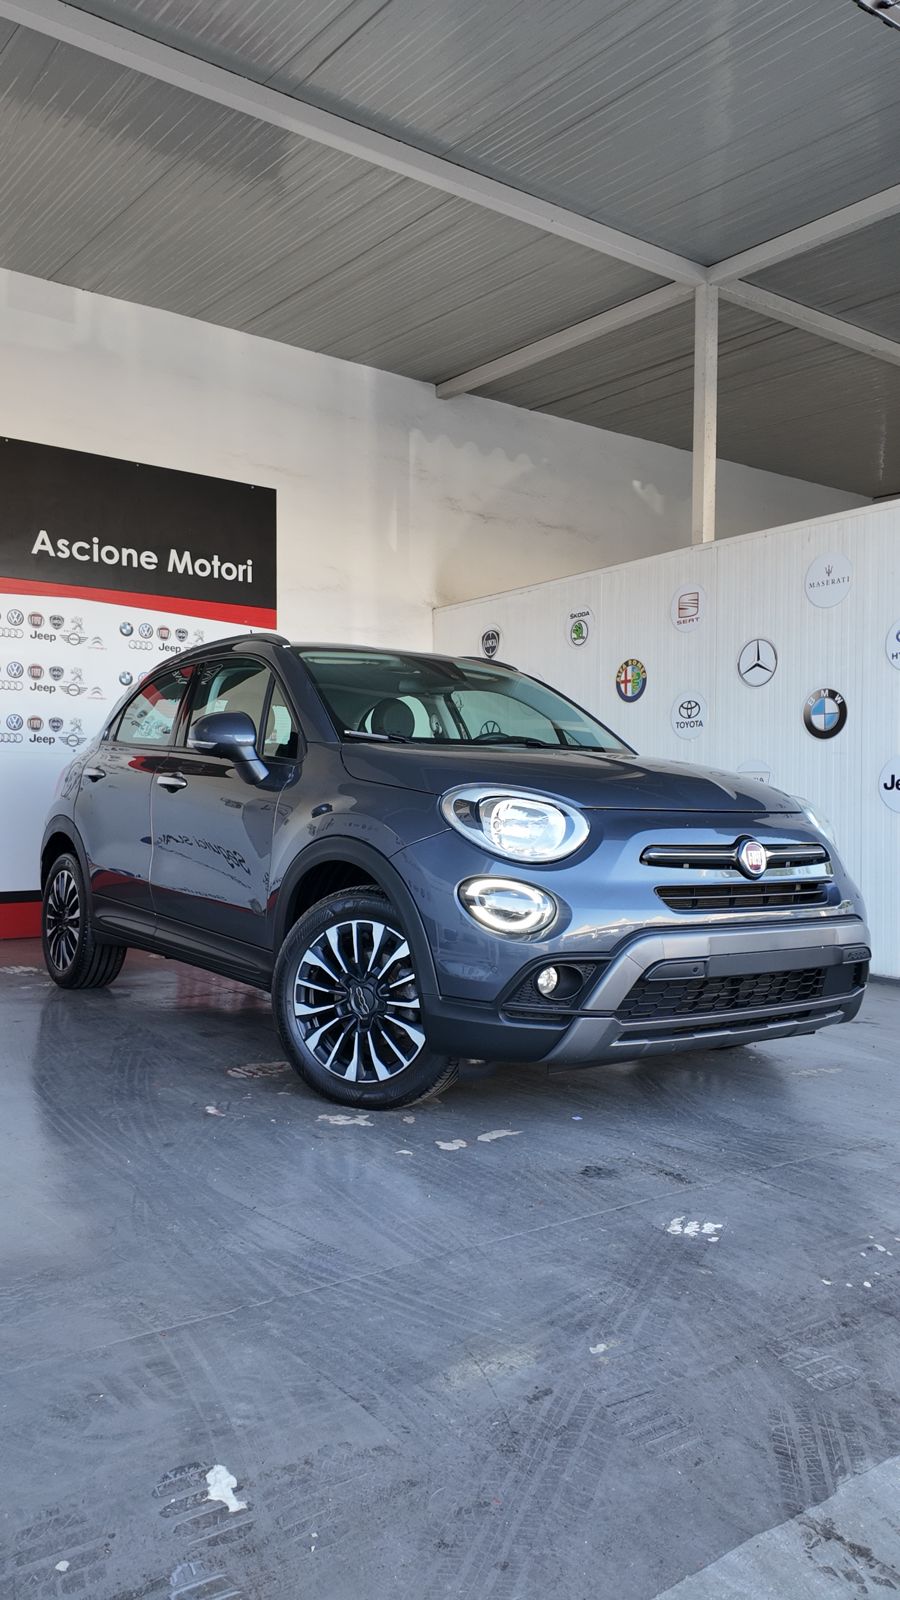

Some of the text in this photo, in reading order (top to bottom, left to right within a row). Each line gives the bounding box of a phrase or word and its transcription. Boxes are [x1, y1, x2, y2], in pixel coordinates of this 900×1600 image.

[31, 529, 253, 583] Ascione Motori
[808, 576, 850, 589] MASERATI
[676, 617, 700, 626] SEAT
[30, 630, 57, 643] Jeep
[158, 643, 181, 654] Jeep
[29, 682, 56, 695] Jeep
[807, 689, 843, 706] BMW
[675, 720, 704, 729] TOYOTA
[29, 734, 56, 746] Jeep
